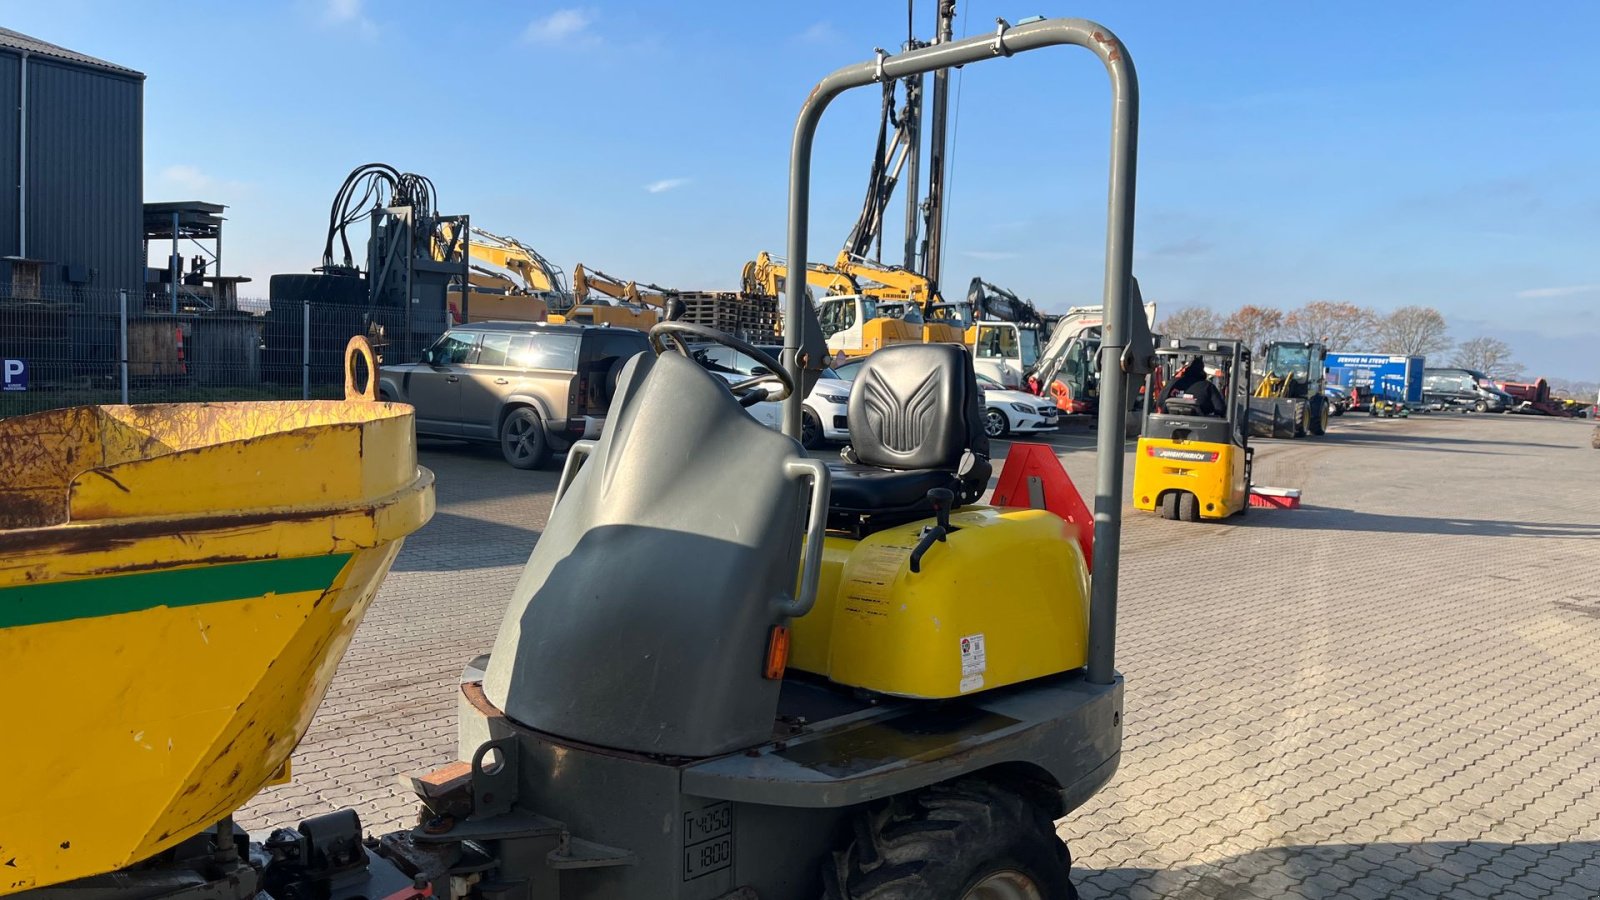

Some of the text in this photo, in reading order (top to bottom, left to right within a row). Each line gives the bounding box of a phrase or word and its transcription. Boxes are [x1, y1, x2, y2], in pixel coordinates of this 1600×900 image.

[4, 359, 24, 383] P
[1337, 356, 1360, 364] SERVICE
[687, 807, 730, 839] T 4050
[687, 840, 730, 873] L 1800
